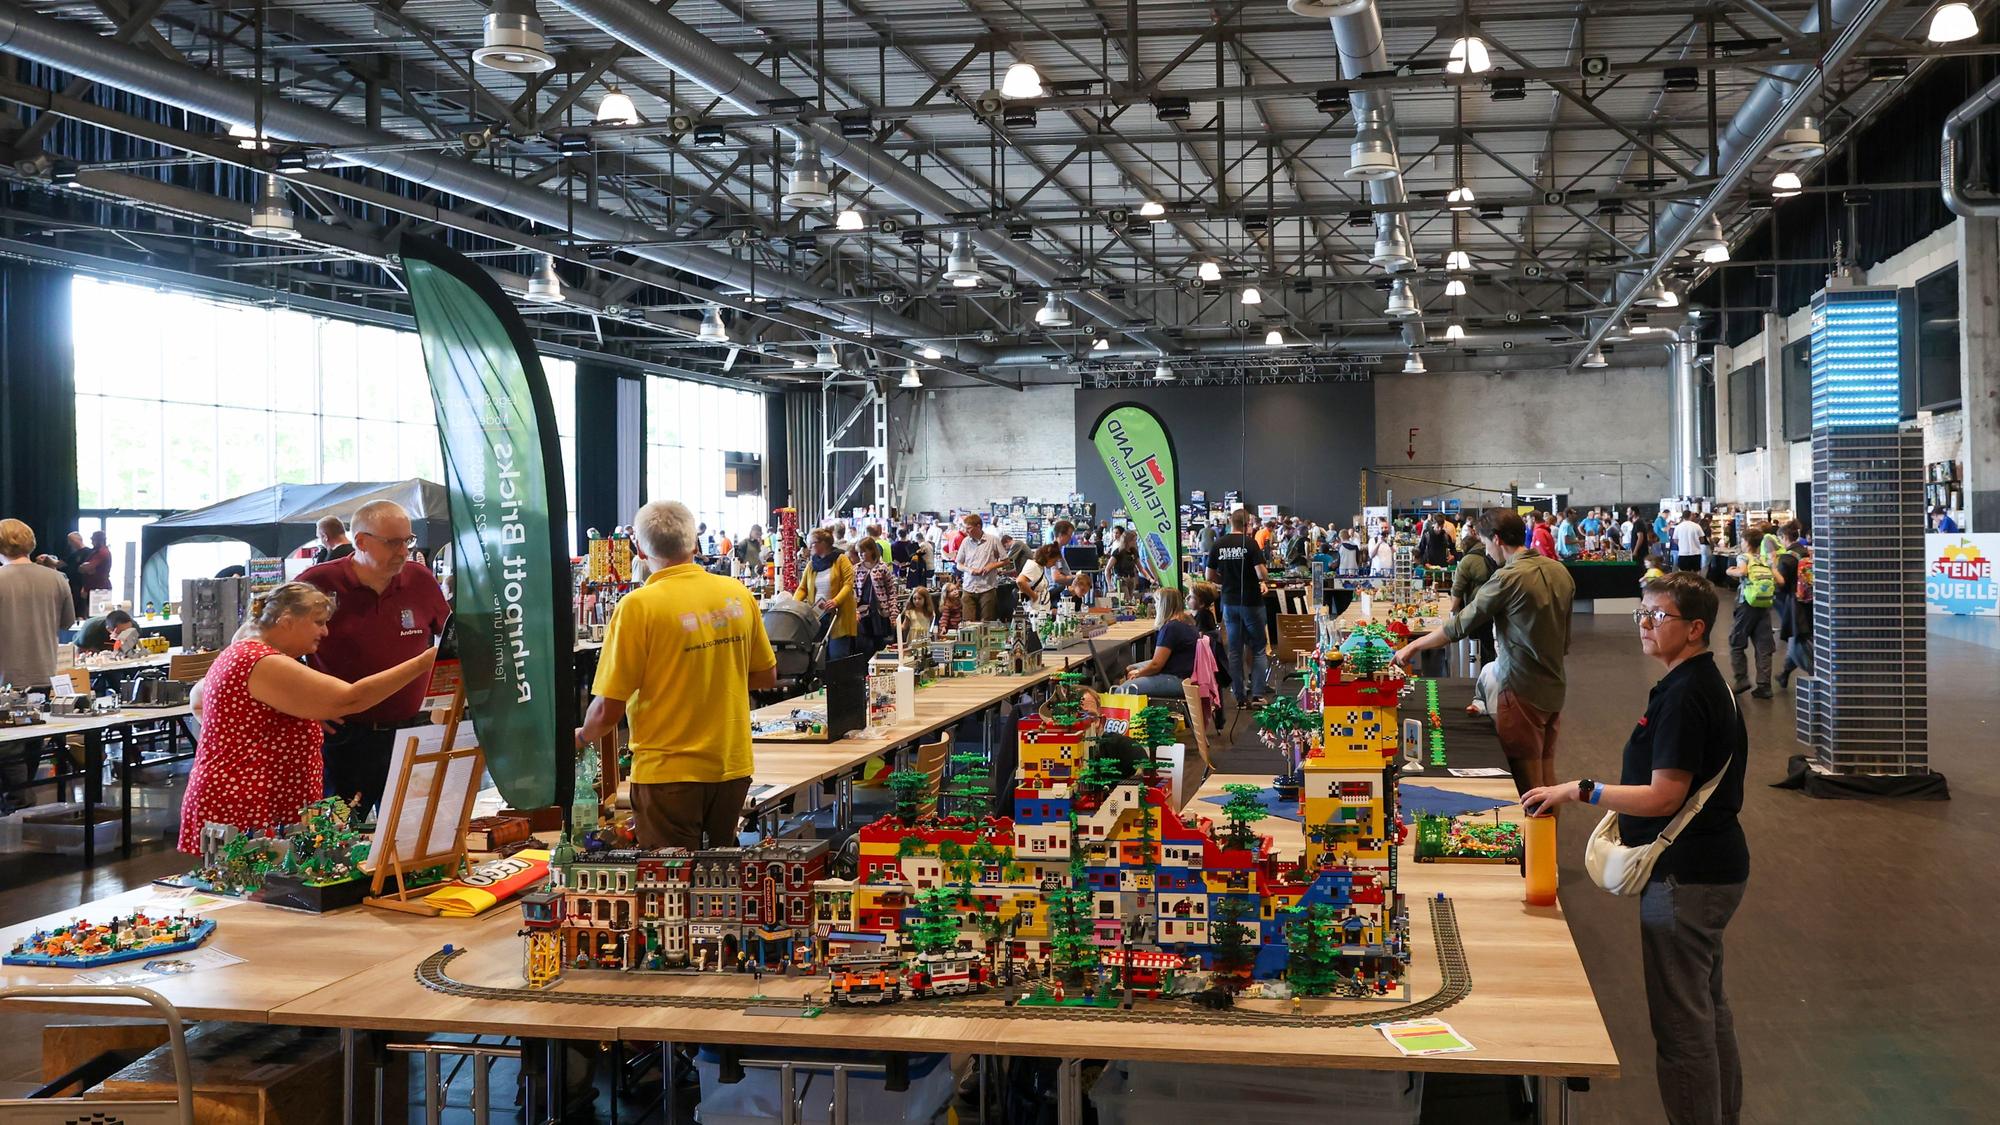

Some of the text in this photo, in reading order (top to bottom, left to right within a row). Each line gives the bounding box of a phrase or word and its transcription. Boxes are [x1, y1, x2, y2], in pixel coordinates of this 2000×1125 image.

[1409, 428, 1420, 443] F
[1931, 561, 1992, 578] STEINE
[1926, 582, 1999, 601] QUELLE
[691, 925, 721, 934] PETS
